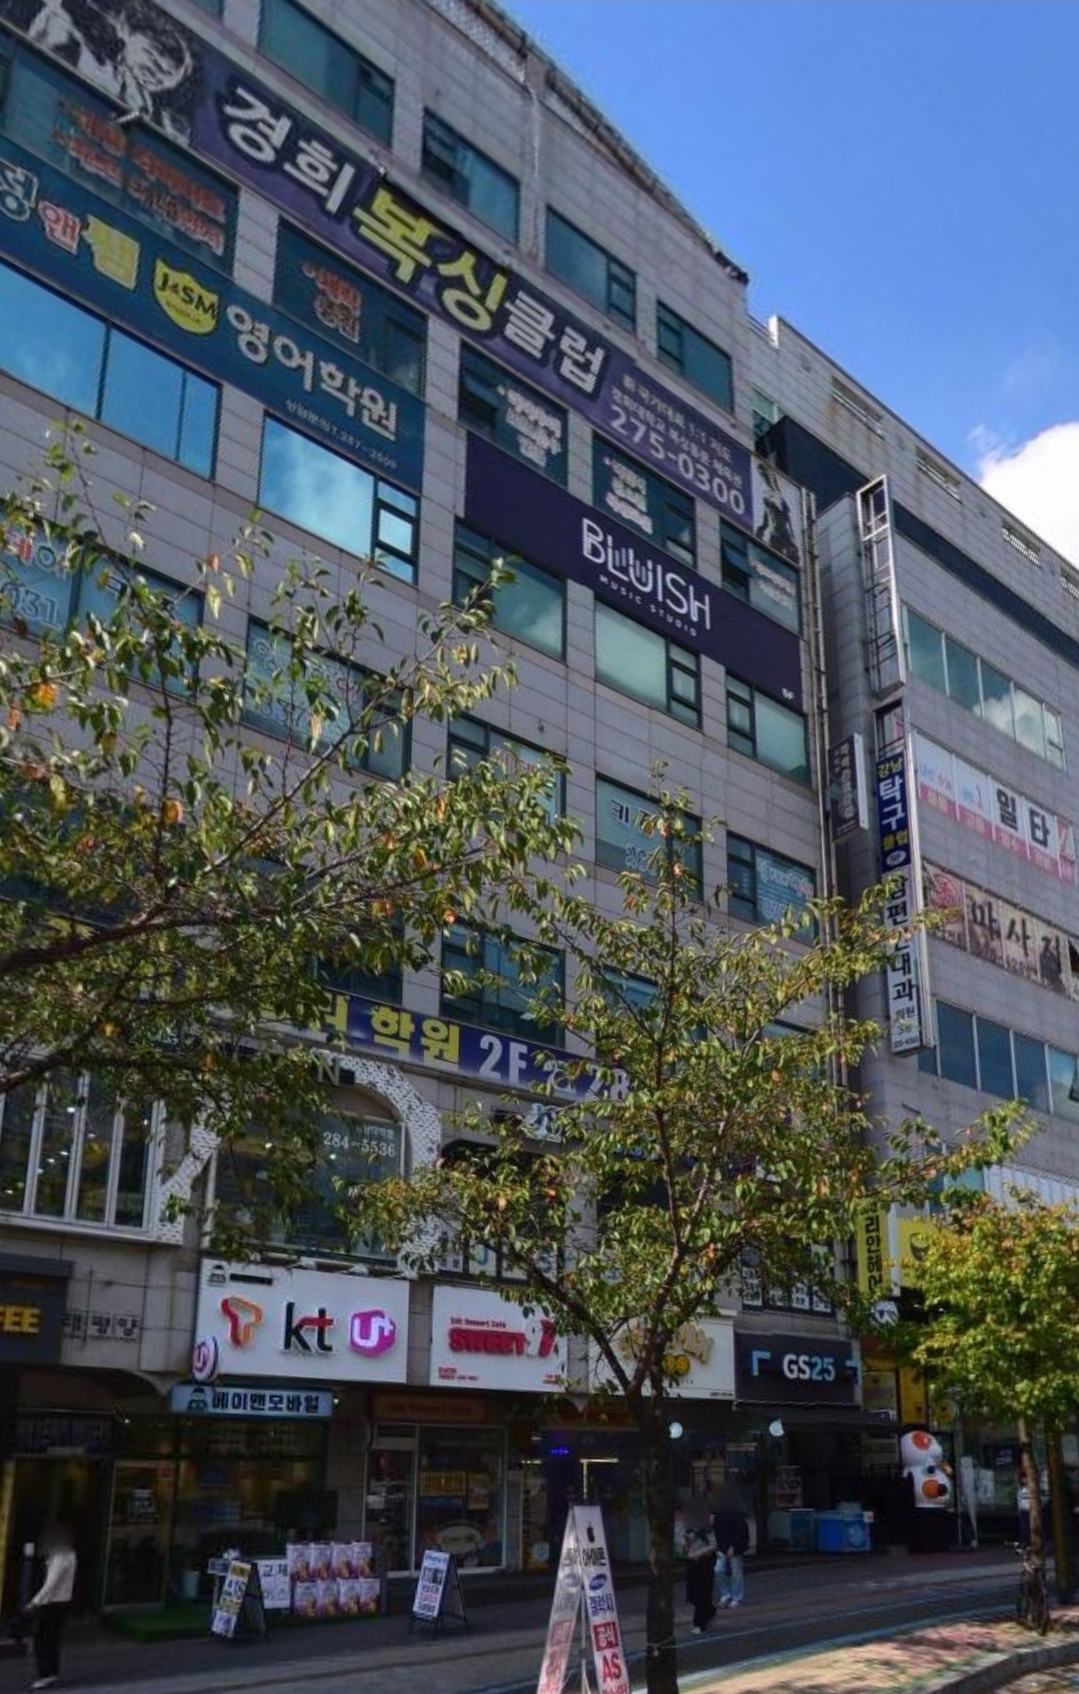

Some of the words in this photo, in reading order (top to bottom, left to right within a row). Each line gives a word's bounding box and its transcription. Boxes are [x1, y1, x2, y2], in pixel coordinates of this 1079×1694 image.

[226, 303, 399, 443] 영어학원
[610, 404, 746, 515] 275-0300
[599, 574, 644, 607] MUSIC
[649, 603, 698, 638] STUDIO
[879, 774, 906, 832] 탁구
[370, 1005, 460, 1066] 학원
[478, 1034, 529, 1088] 2F
[322, 1131, 397, 1158] 284-5536
[282, 1301, 335, 1354] kt
[783, 1354, 836, 1382] GS25
[602, 1652, 622, 1683] AS
